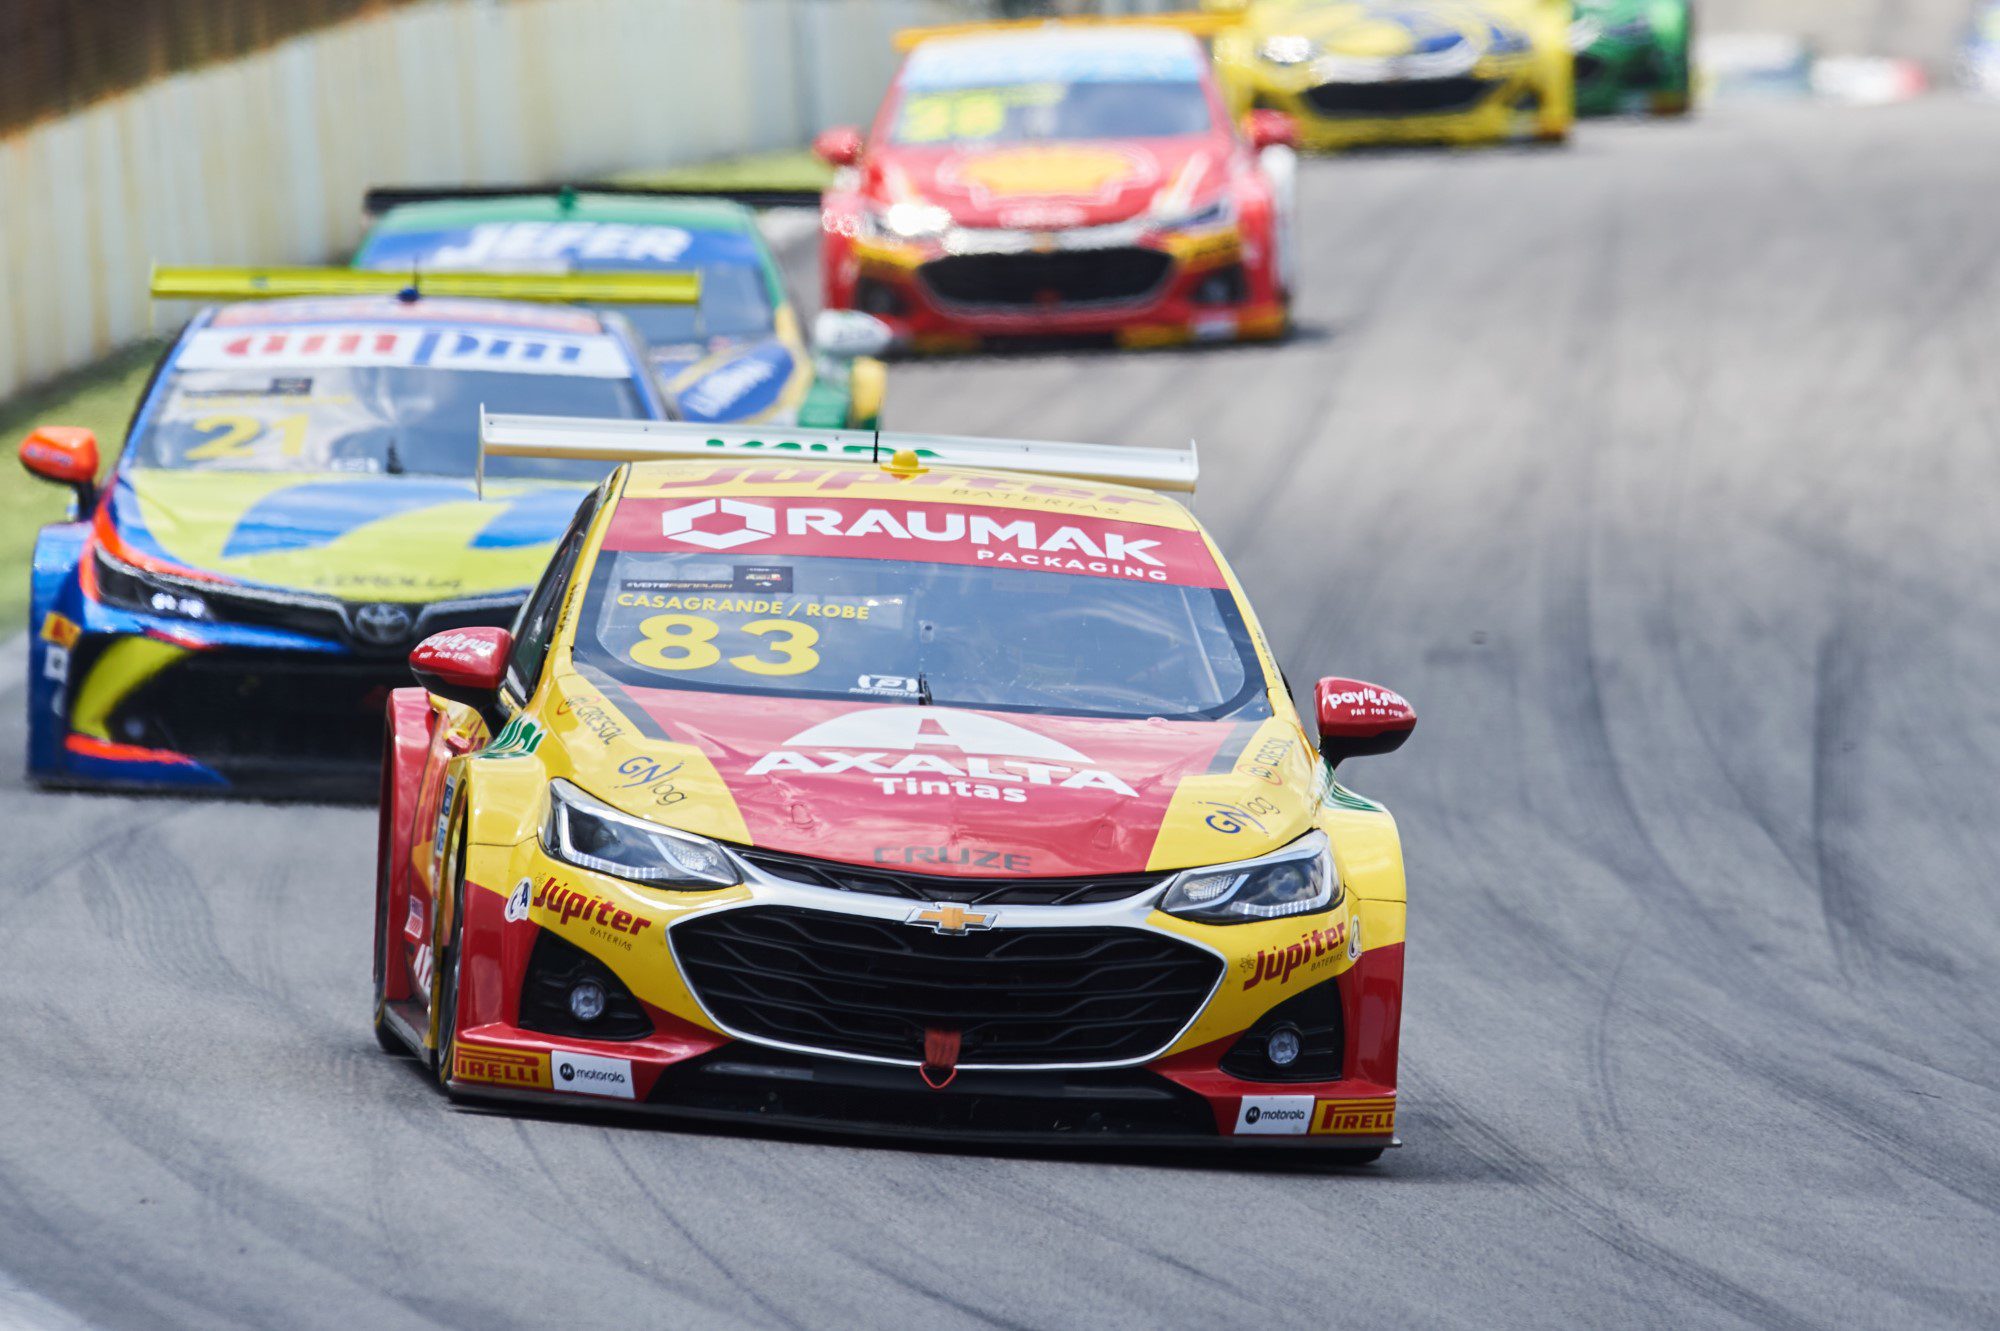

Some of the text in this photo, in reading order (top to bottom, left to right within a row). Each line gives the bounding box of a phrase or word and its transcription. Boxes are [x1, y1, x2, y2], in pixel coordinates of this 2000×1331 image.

[185, 414, 309, 461] 21
[952, 488, 1121, 515] BATERIAS
[787, 507, 1167, 568] RAUMAK
[977, 549, 1168, 581] PACKAGING
[616, 592, 784, 616] CASAGRANDE
[628, 613, 820, 677] 83
[1350, 708, 1366, 716] PAY
[1371, 708, 1386, 716] FOR
[744, 751, 1141, 798] AXALTA
[873, 777, 1028, 803] Tintas
[873, 846, 1032, 873] CRUZE
[532, 876, 652, 936] Júpiter
[589, 926, 632, 952] BATERIAS
[1242, 921, 1345, 992] Júpiter
[576, 1067, 626, 1084] motorola
[1261, 1108, 1306, 1121] motorola
